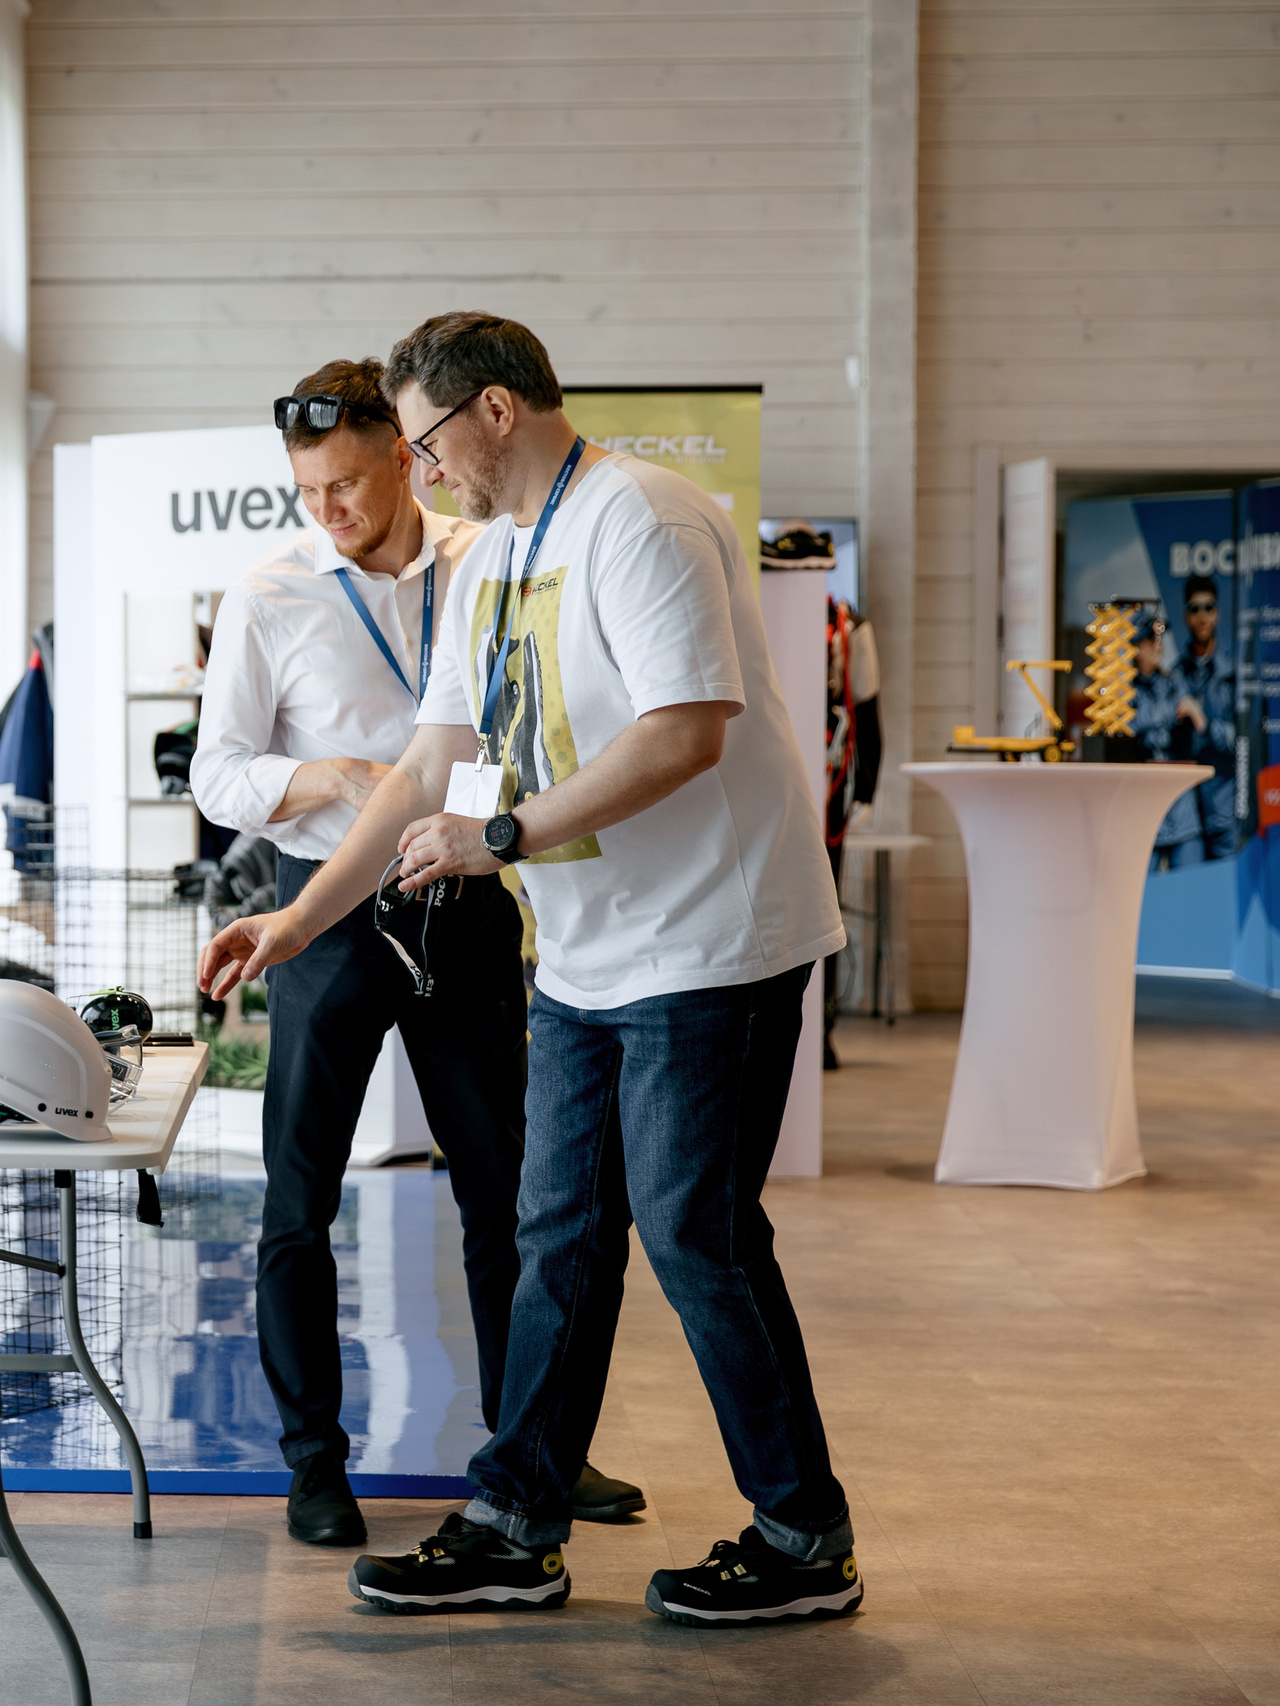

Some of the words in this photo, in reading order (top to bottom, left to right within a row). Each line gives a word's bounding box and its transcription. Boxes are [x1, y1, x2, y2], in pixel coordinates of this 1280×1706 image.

[587, 435, 726, 456] HECKEL
[171, 486, 305, 533] uvex
[111, 1009, 120, 1030] vex
[55, 1107, 78, 1117] uvex
